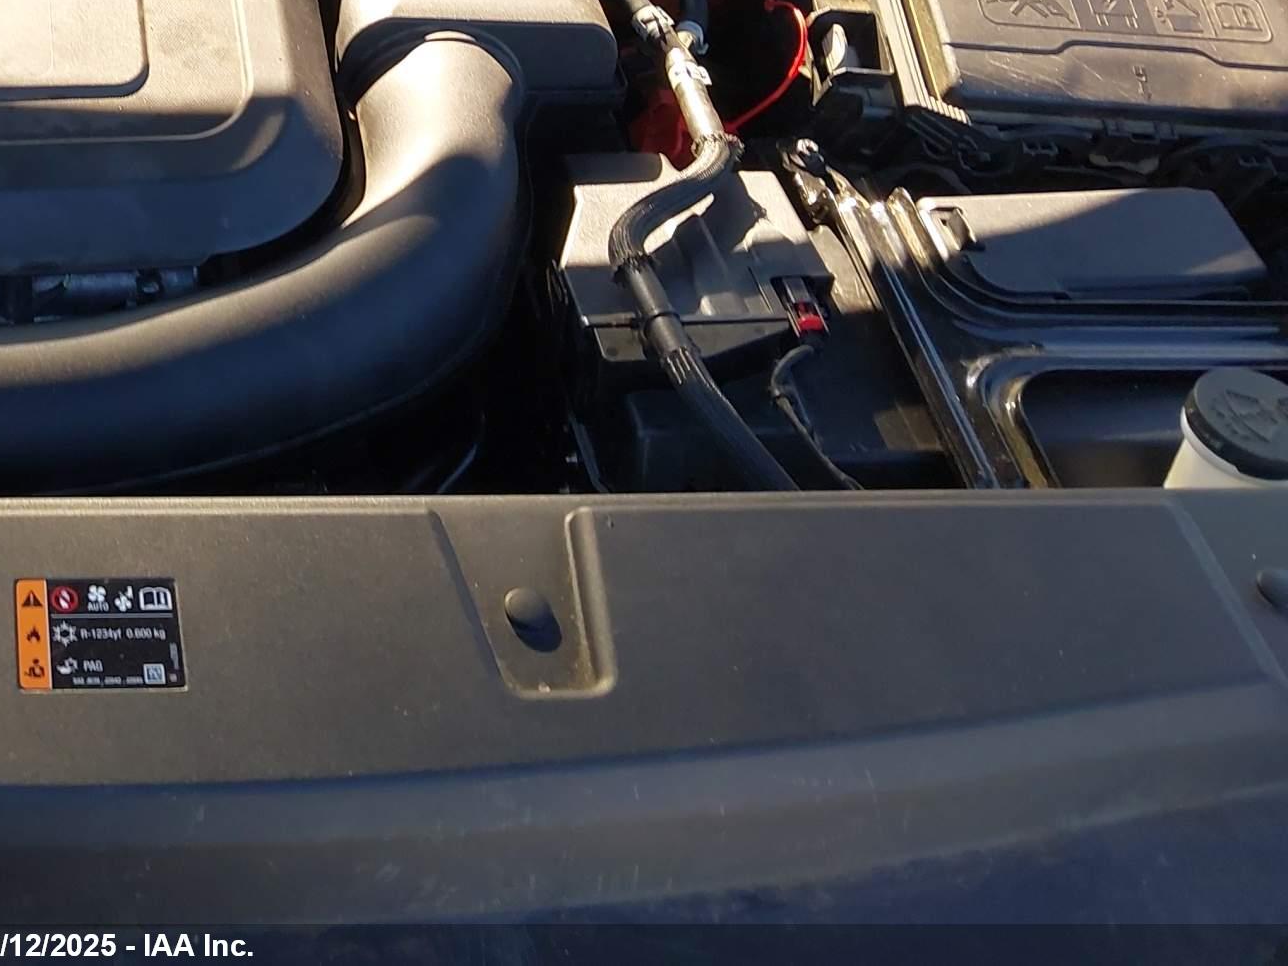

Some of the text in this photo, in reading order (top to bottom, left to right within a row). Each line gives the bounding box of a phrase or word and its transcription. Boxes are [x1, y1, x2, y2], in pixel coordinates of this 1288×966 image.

[87, 601, 109, 612] AUTO
[80, 627, 122, 641] R-1234yf
[153, 627, 166, 641] kg
